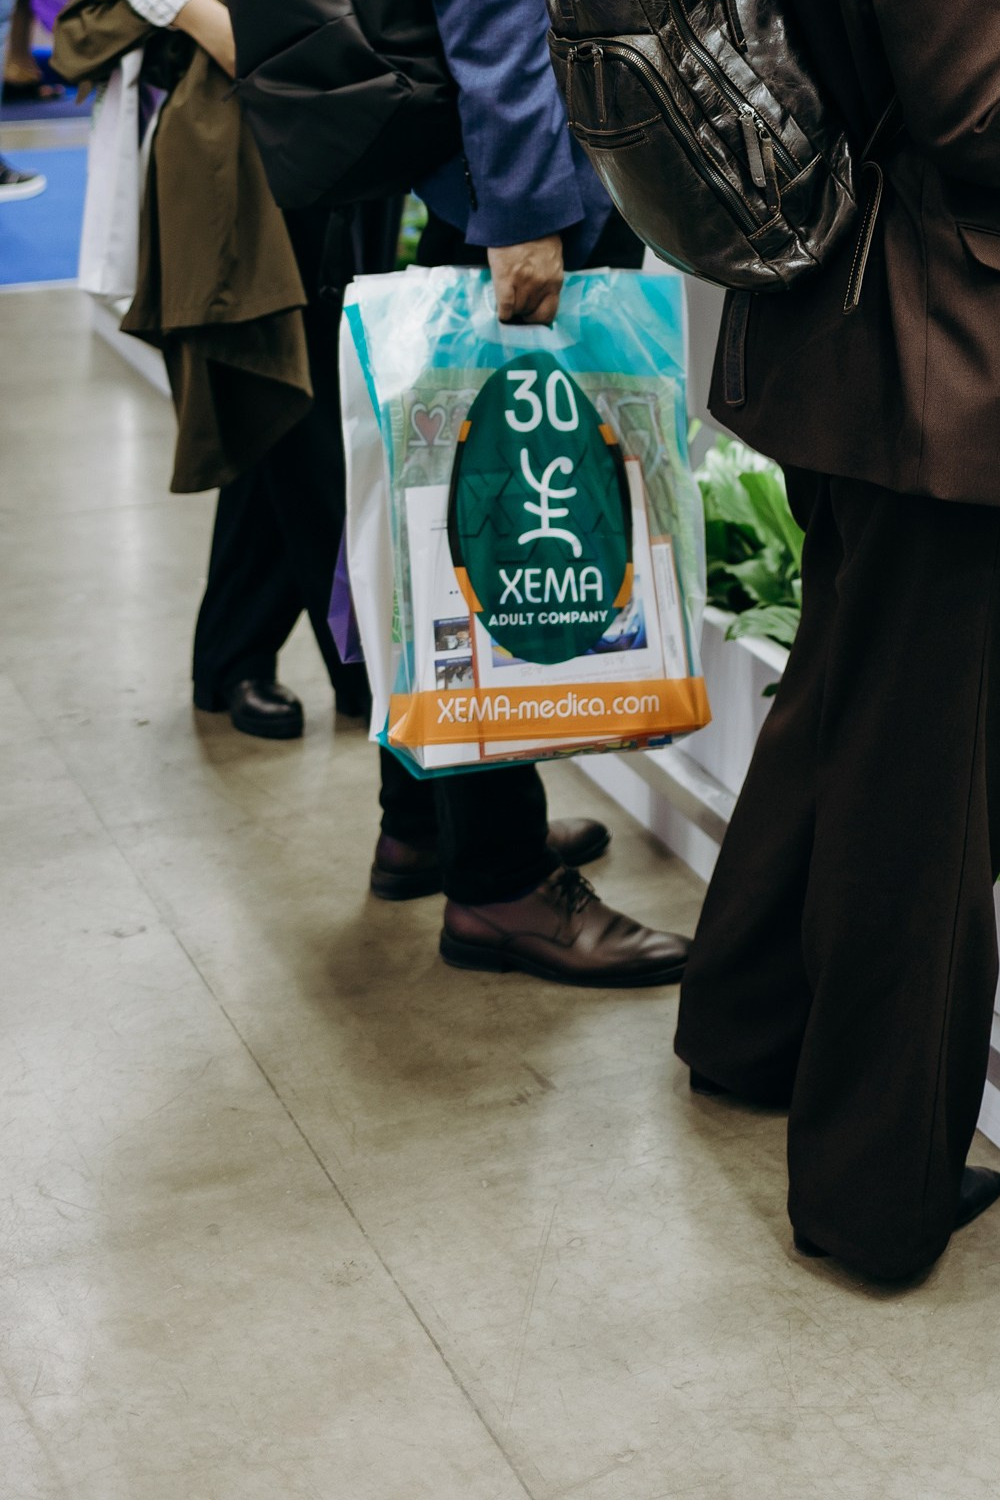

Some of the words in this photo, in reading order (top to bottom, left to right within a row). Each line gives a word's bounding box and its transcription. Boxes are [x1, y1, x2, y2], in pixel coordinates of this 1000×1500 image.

[504, 369, 579, 433] 30
[499, 566, 604, 605] XEMA
[488, 612, 535, 627] ADULT
[537, 610, 609, 626] COMPANY
[436, 691, 660, 724] XEMA-medica.com
